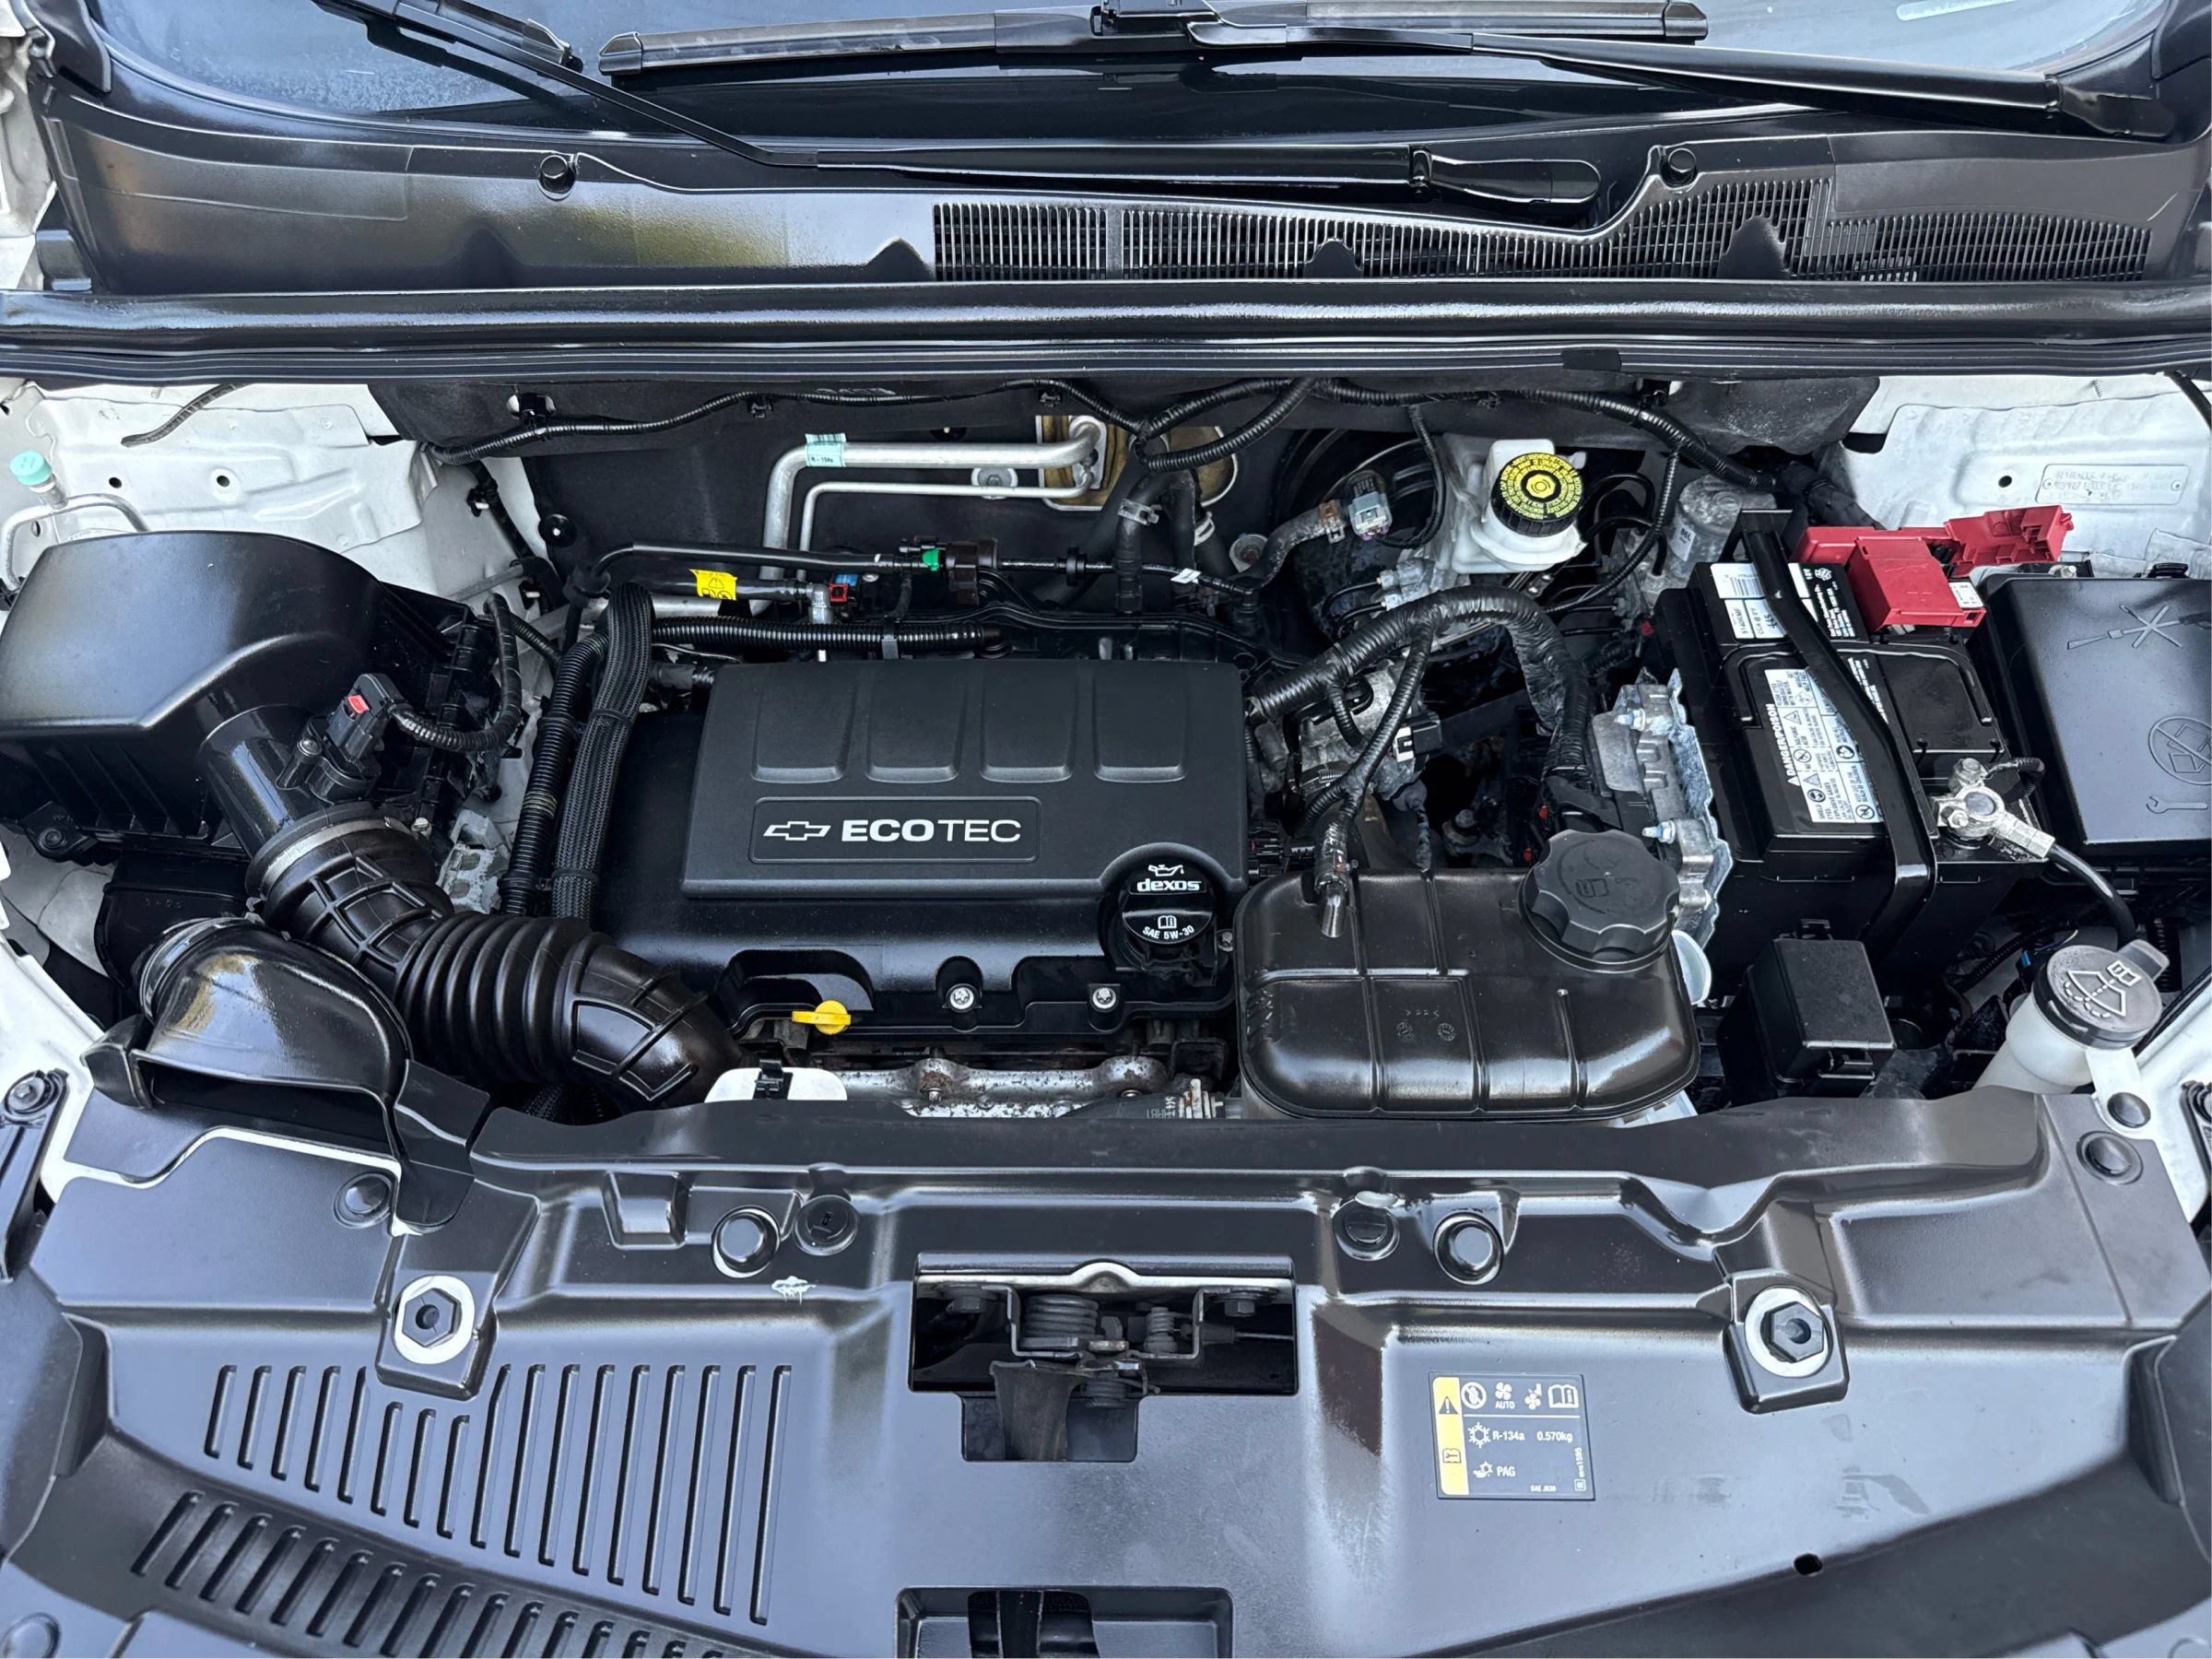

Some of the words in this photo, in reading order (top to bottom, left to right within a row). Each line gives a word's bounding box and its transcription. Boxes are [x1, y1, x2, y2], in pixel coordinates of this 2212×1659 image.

[841, 819, 1021, 842] ECOTEC
[1137, 877, 1202, 892] dexos
[1143, 926, 1160, 939] SAE
[1163, 925, 1194, 940] 5W-30
[1495, 1401, 1515, 1409] AUTO
[1492, 1431, 1525, 1441] R-134a
[1536, 1431, 1573, 1443] 0.570kg
[1497, 1466, 1516, 1477] PAG
